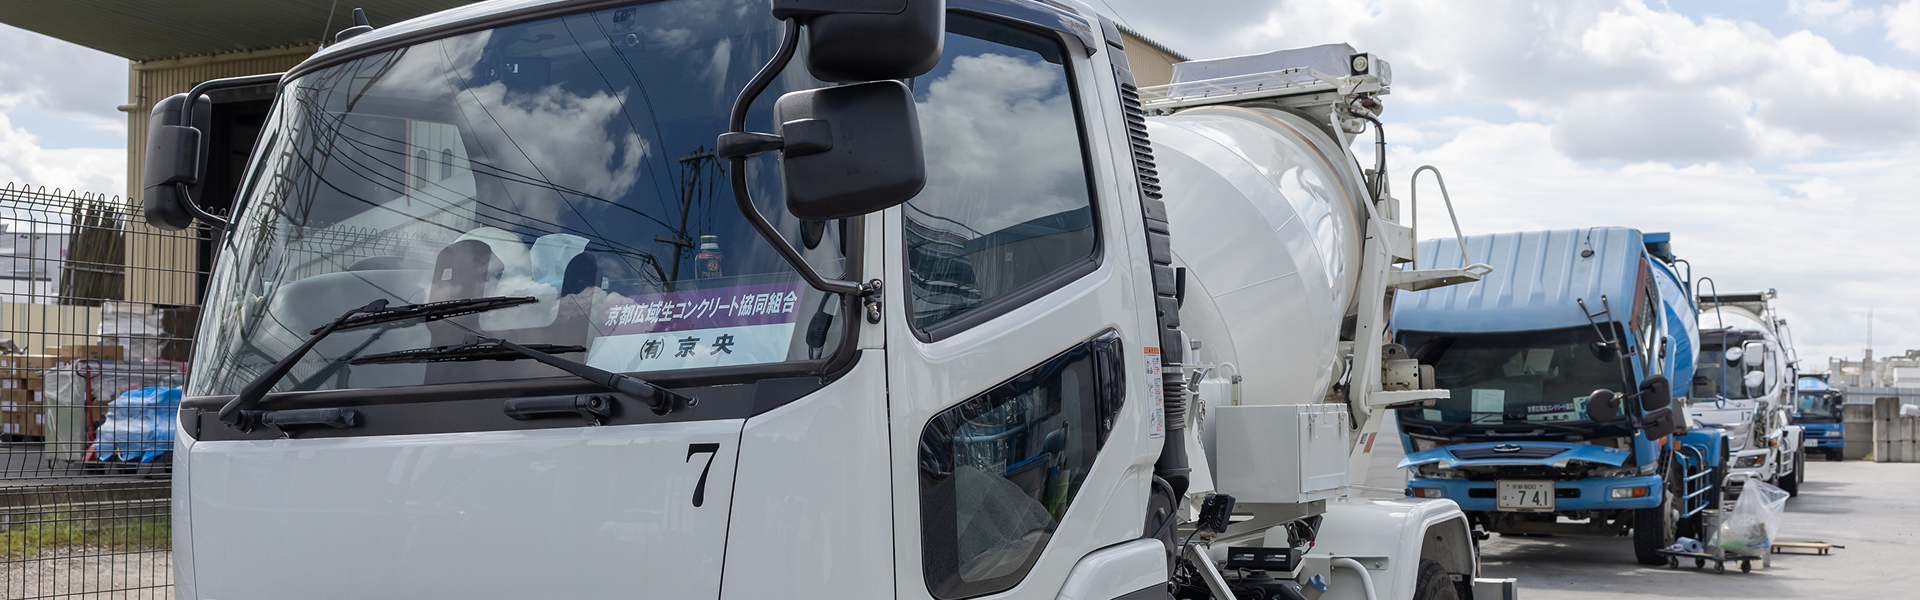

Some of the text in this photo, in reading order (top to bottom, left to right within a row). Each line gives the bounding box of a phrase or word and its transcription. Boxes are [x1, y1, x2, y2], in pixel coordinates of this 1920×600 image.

[604, 290, 798, 327] 京都広域生コンクリート協同組合
[1741, 411, 1752, 421] 17
[685, 442, 720, 508] 7
